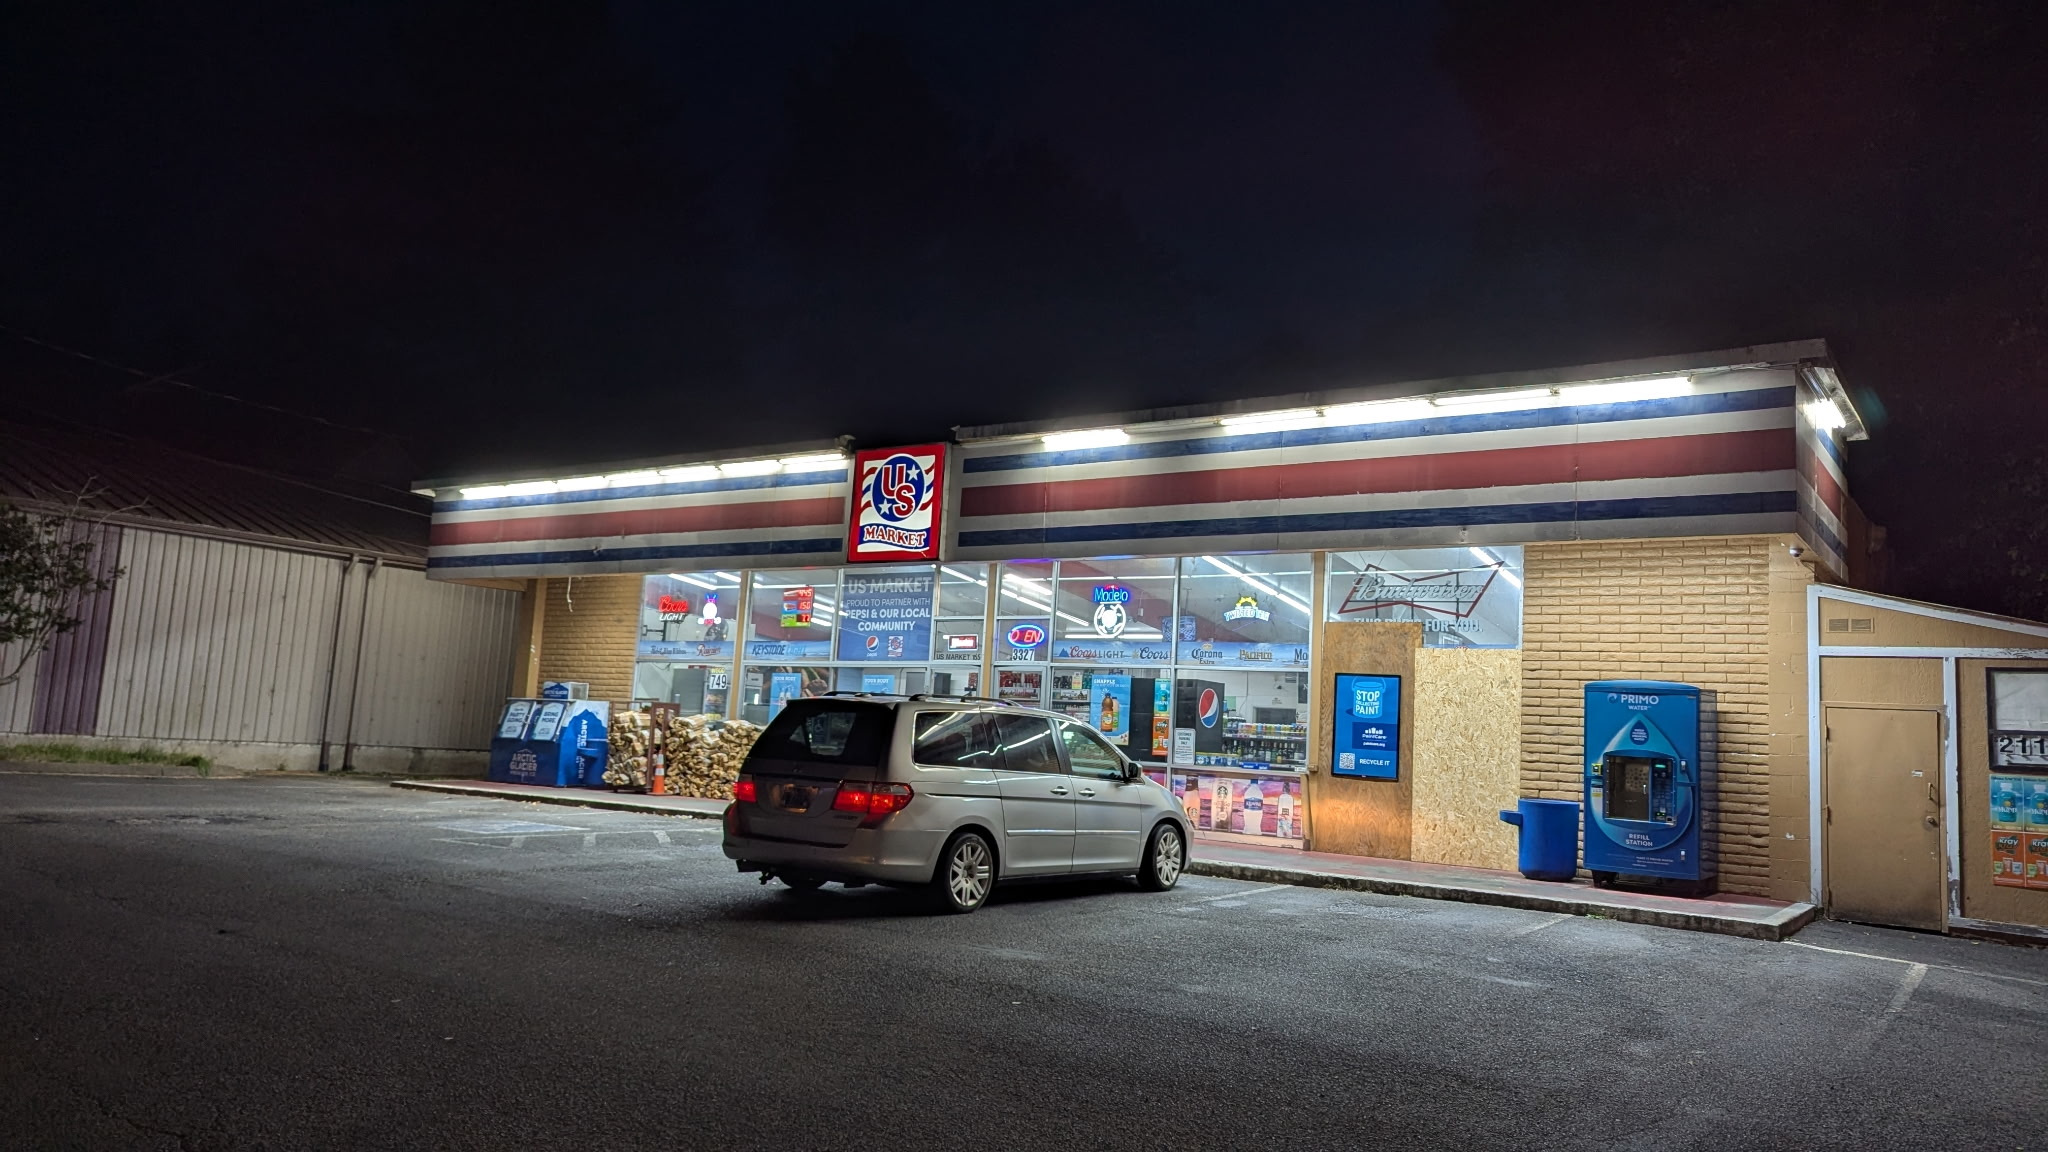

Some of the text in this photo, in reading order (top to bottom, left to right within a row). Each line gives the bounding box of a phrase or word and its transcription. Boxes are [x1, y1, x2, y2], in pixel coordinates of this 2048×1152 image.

[881, 464, 916, 518] US
[863, 525, 927, 547] MARKET
[848, 577, 932, 594] US MARKET
[1352, 575, 1483, 601] Budweiser
[1094, 587, 1129, 602] Modelo
[846, 597, 931, 608] PROUD TO PARTNER WITH
[659, 612, 685, 621] LIGHT
[845, 607, 931, 619] PEPSI & OUR LOCAL
[857, 620, 917, 632] COMMUNITY
[1425, 619, 1447, 632] FOR
[1010, 629, 1042, 643] OEN
[751, 644, 786, 656] KEYSTONE
[1012, 648, 1035, 661] 3327
[1069, 645, 1125, 659] Coors LIGHT
[1139, 647, 1169, 660] Coors
[1191, 648, 1223, 661] Corona
[936, 653, 945, 661] US
[945, 653, 971, 661] MARKET
[709, 674, 728, 689] 749
[1356, 689, 1380, 702] STOP
[1620, 694, 1659, 705] PRIMO
[1355, 705, 1380, 715] PAINT
[580, 719, 589, 747] ARCTIC
[511, 753, 537, 762] ARCTIC
[1359, 758, 1384, 766] RECYCLE
[509, 762, 537, 771] GLACIER
[1625, 838, 1653, 847] STATION
[1628, 833, 1650, 841] REFILL
